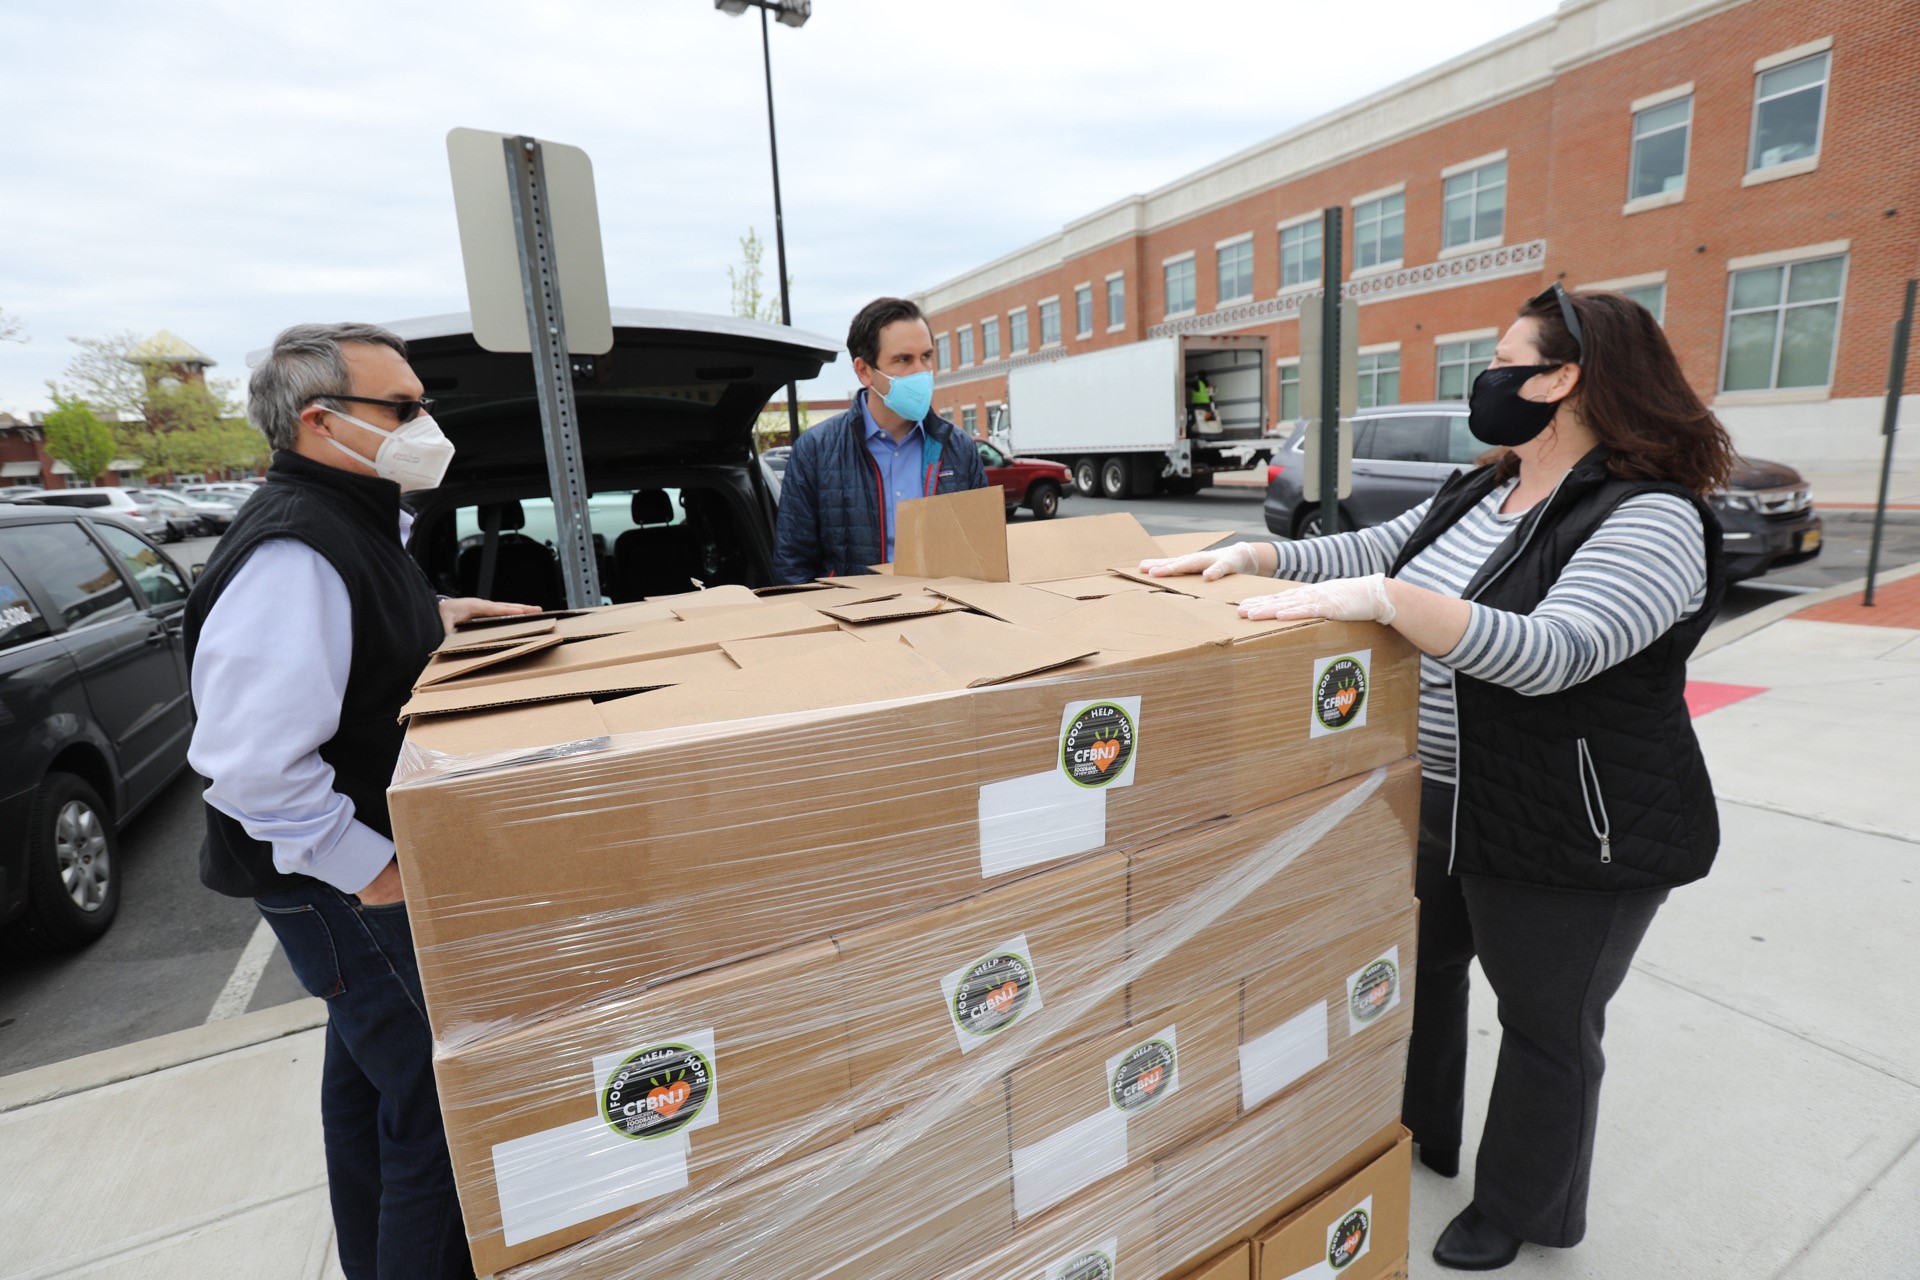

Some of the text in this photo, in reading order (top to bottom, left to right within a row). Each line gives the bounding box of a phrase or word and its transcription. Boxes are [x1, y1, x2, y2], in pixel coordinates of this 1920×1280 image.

[1318, 674, 1330, 701] FOOD
[1335, 661, 1352, 671] HELP
[1323, 693, 1353, 710] CFBNJ
[1067, 708, 1131, 752] FOOD HELP HOPE
[1074, 746, 1115, 763] CFBNJ
[958, 958, 1027, 1016] FOOD HELP HOPE
[970, 986, 1015, 1019] CFBNJ
[1133, 1045, 1153, 1060] HELP
[610, 1049, 706, 1108] FOOD HELP HOPE
[623, 1088, 684, 1117] CFBNJ
